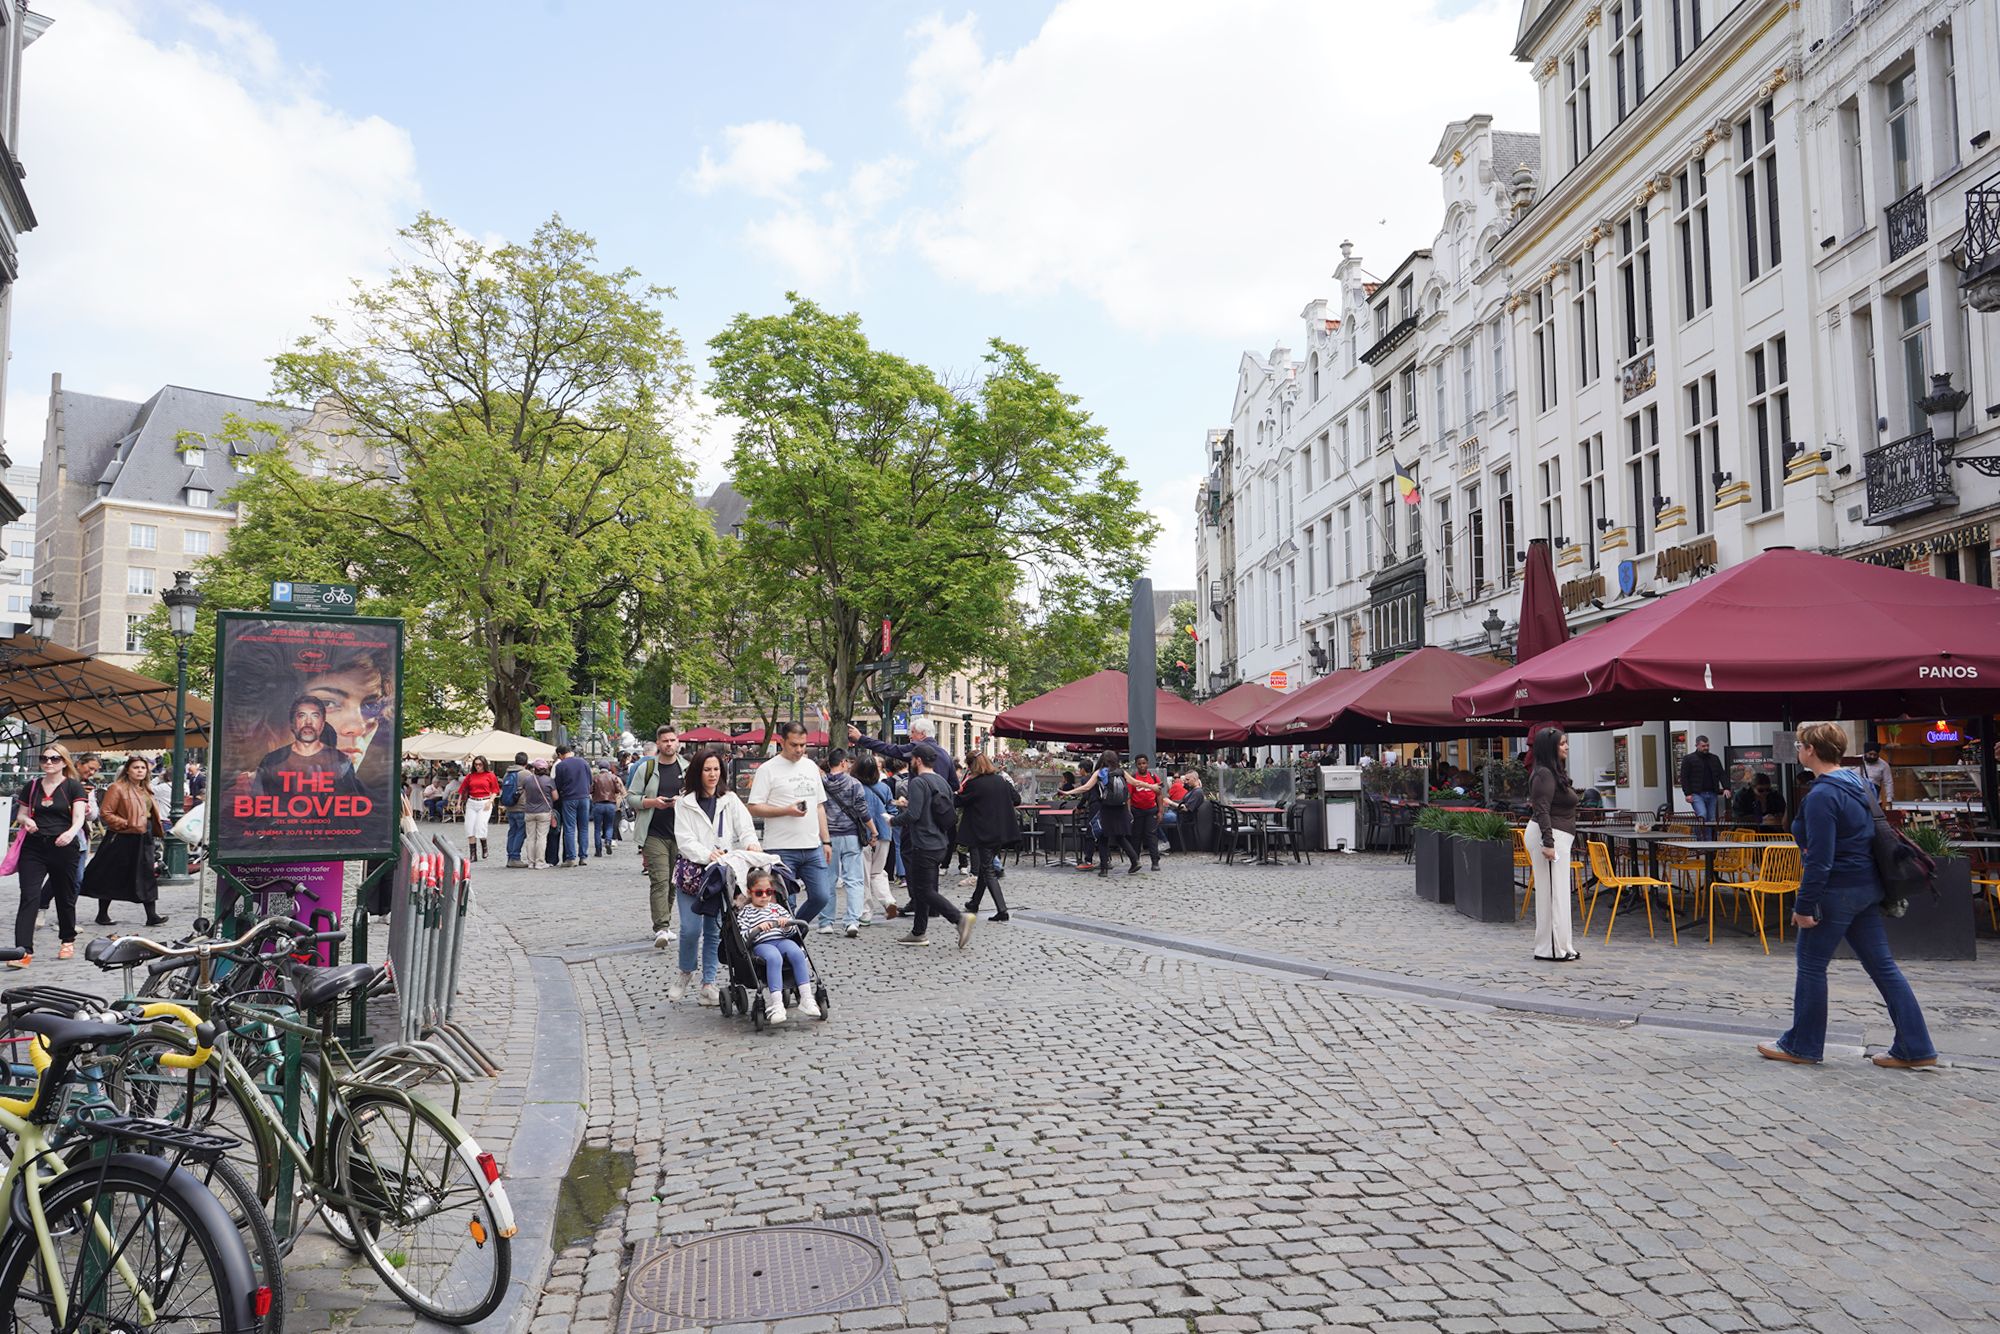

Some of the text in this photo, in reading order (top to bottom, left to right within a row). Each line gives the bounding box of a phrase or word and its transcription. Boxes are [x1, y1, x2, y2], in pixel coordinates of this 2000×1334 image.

[275, 583, 290, 601] P
[1919, 666, 1978, 678] PANOS
[277, 771, 335, 793] THE
[234, 795, 373, 817] BELOVED
[237, 866, 272, 874] Together,
[312, 865, 330, 873] safer
